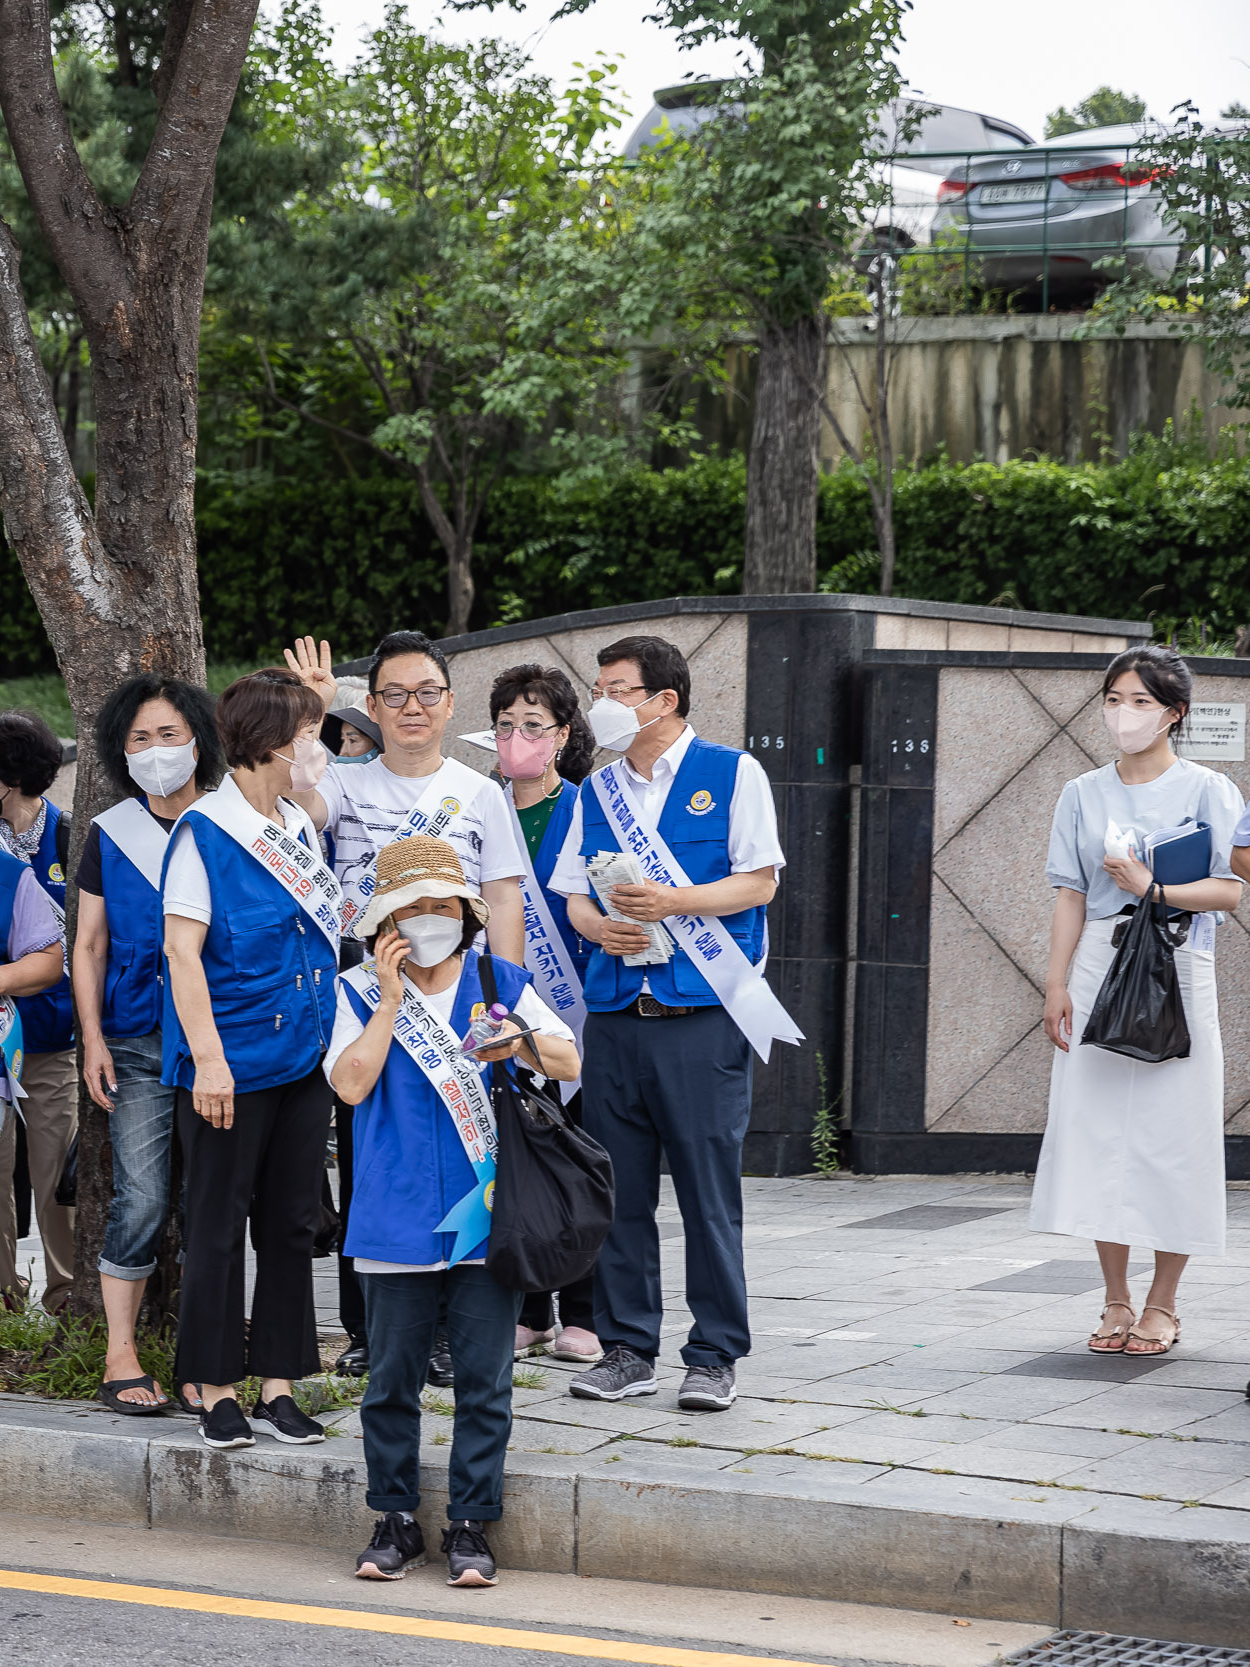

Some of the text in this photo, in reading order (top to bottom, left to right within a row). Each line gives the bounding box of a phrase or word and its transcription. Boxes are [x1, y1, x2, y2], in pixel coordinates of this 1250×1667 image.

[749, 736, 785, 749] 135
[890, 739, 930, 753] 136
[251, 837, 314, 898] 코로나19
[263, 824, 339, 901] 여름철 행락
[626, 825, 652, 857] 위한
[694, 931, 724, 962] 운동
[533, 943, 565, 983] 지키기
[550, 982, 577, 1011] 운동
